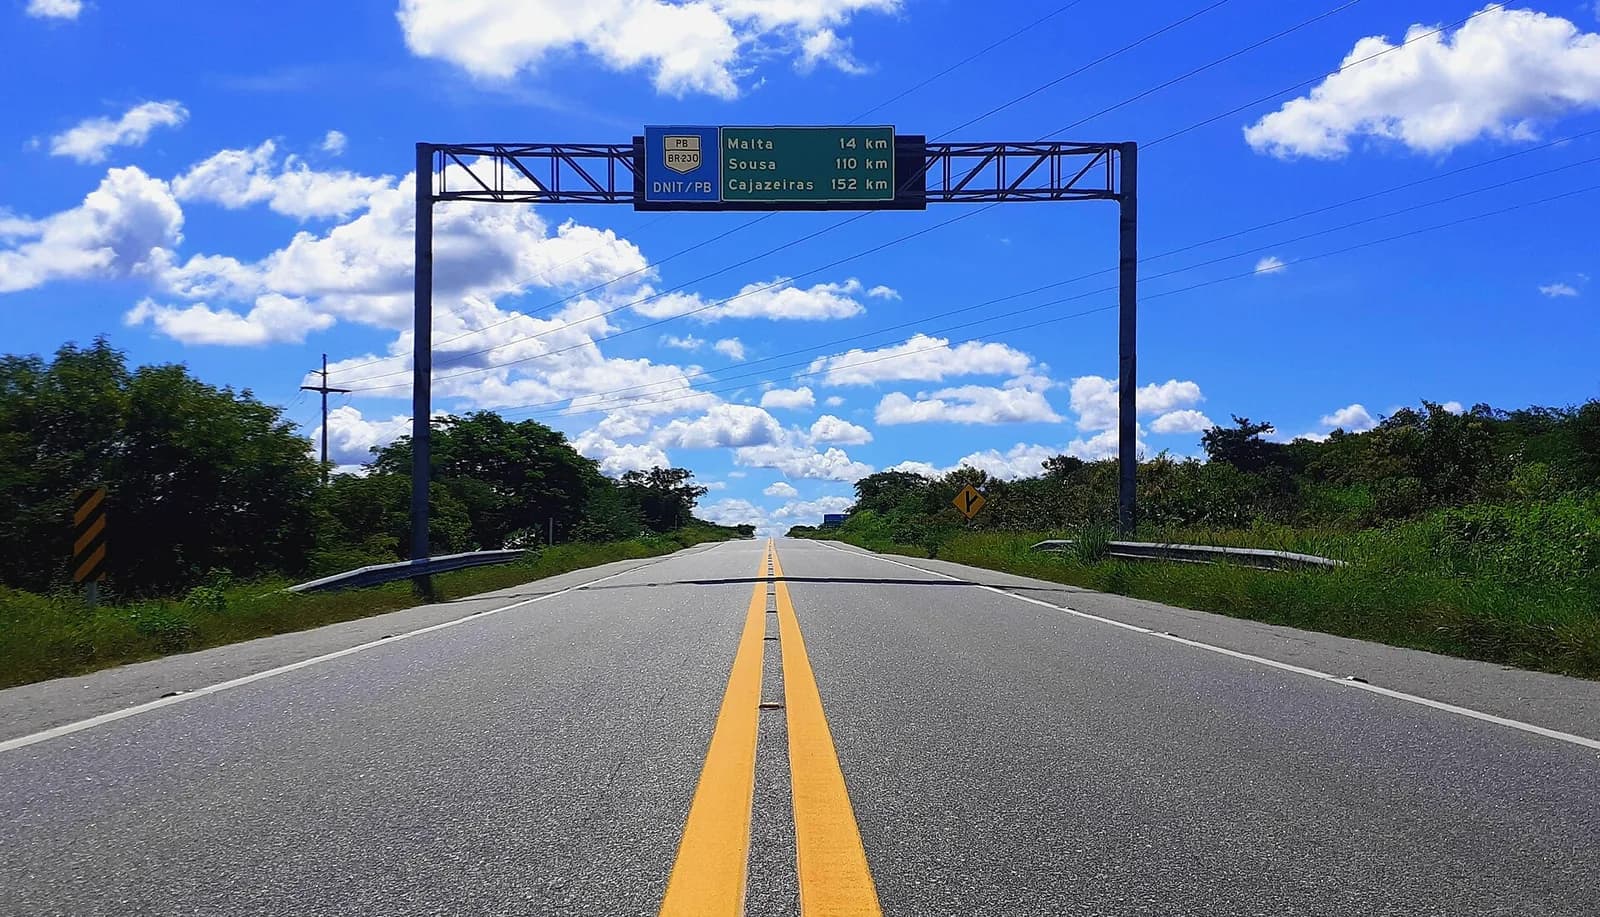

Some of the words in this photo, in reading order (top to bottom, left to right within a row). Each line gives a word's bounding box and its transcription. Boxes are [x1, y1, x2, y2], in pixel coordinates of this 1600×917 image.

[676, 139, 688, 148] PB
[728, 139, 773, 149] Malta
[840, 139, 856, 149] 14
[866, 139, 887, 149] km
[668, 154, 698, 163] BR-230
[729, 159, 776, 169] Sousa
[836, 159, 857, 169] 110
[866, 158, 887, 169] km
[654, 183, 712, 193] DNIT/PB
[729, 179, 814, 192] Cajazeiras
[831, 179, 856, 190] 152
[866, 179, 887, 189] km
